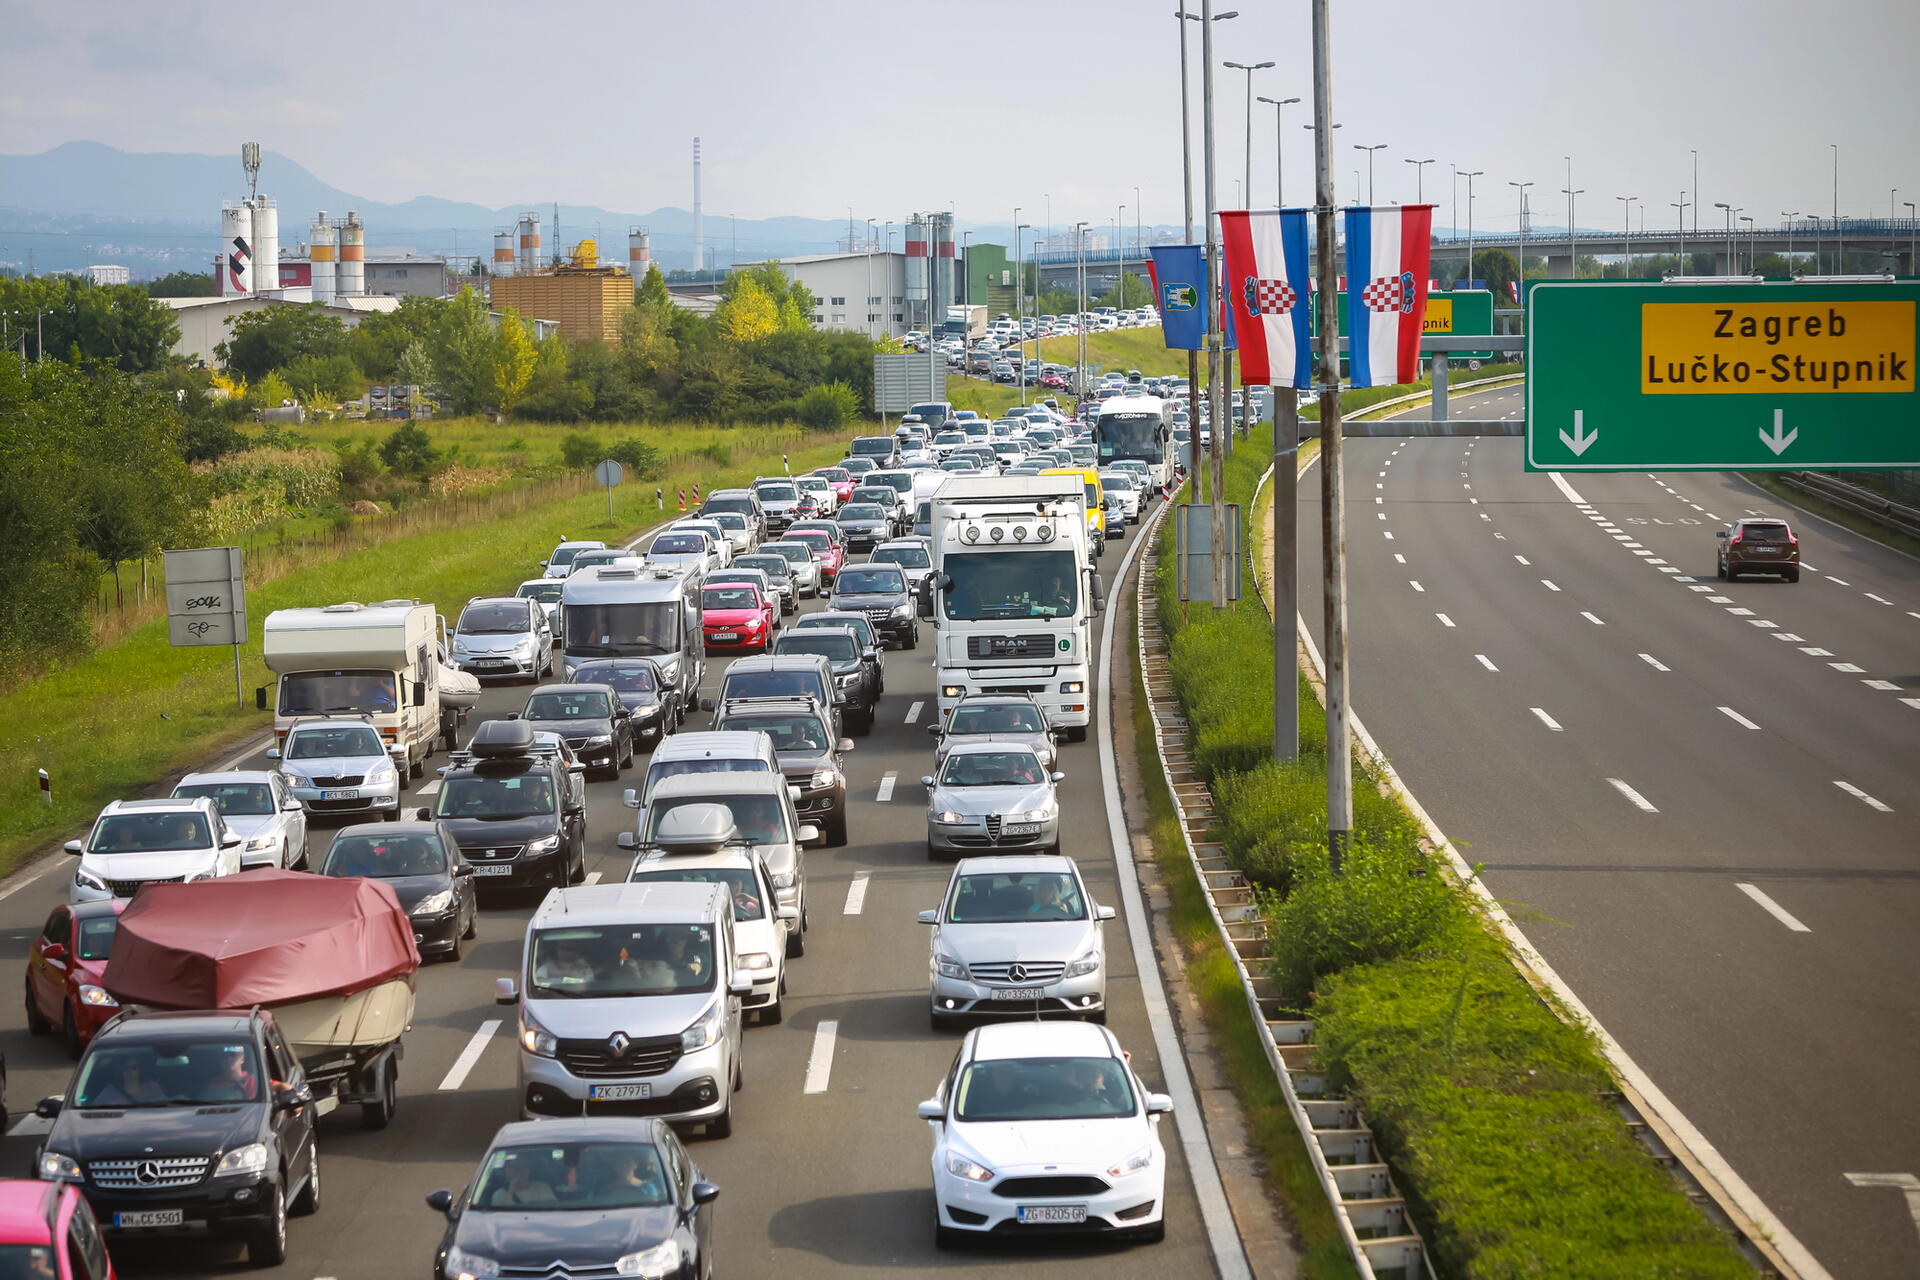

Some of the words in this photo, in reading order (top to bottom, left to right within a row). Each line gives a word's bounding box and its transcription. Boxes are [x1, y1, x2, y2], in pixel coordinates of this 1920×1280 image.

[1714, 308, 1846, 346] Zagreb
[1648, 352, 1908, 390] Lučko-Stupnik
[995, 639, 1028, 647] MAN
[1060, 640, 1068, 650] L
[997, 990, 1007, 1000] ZG
[597, 1087, 612, 1098] ZK
[616, 1085, 648, 1097] 2797E
[121, 1215, 134, 1225] WN
[141, 1213, 154, 1225] CC
[156, 1211, 180, 1224] 5501
[1025, 1208, 1038, 1220] ZG
